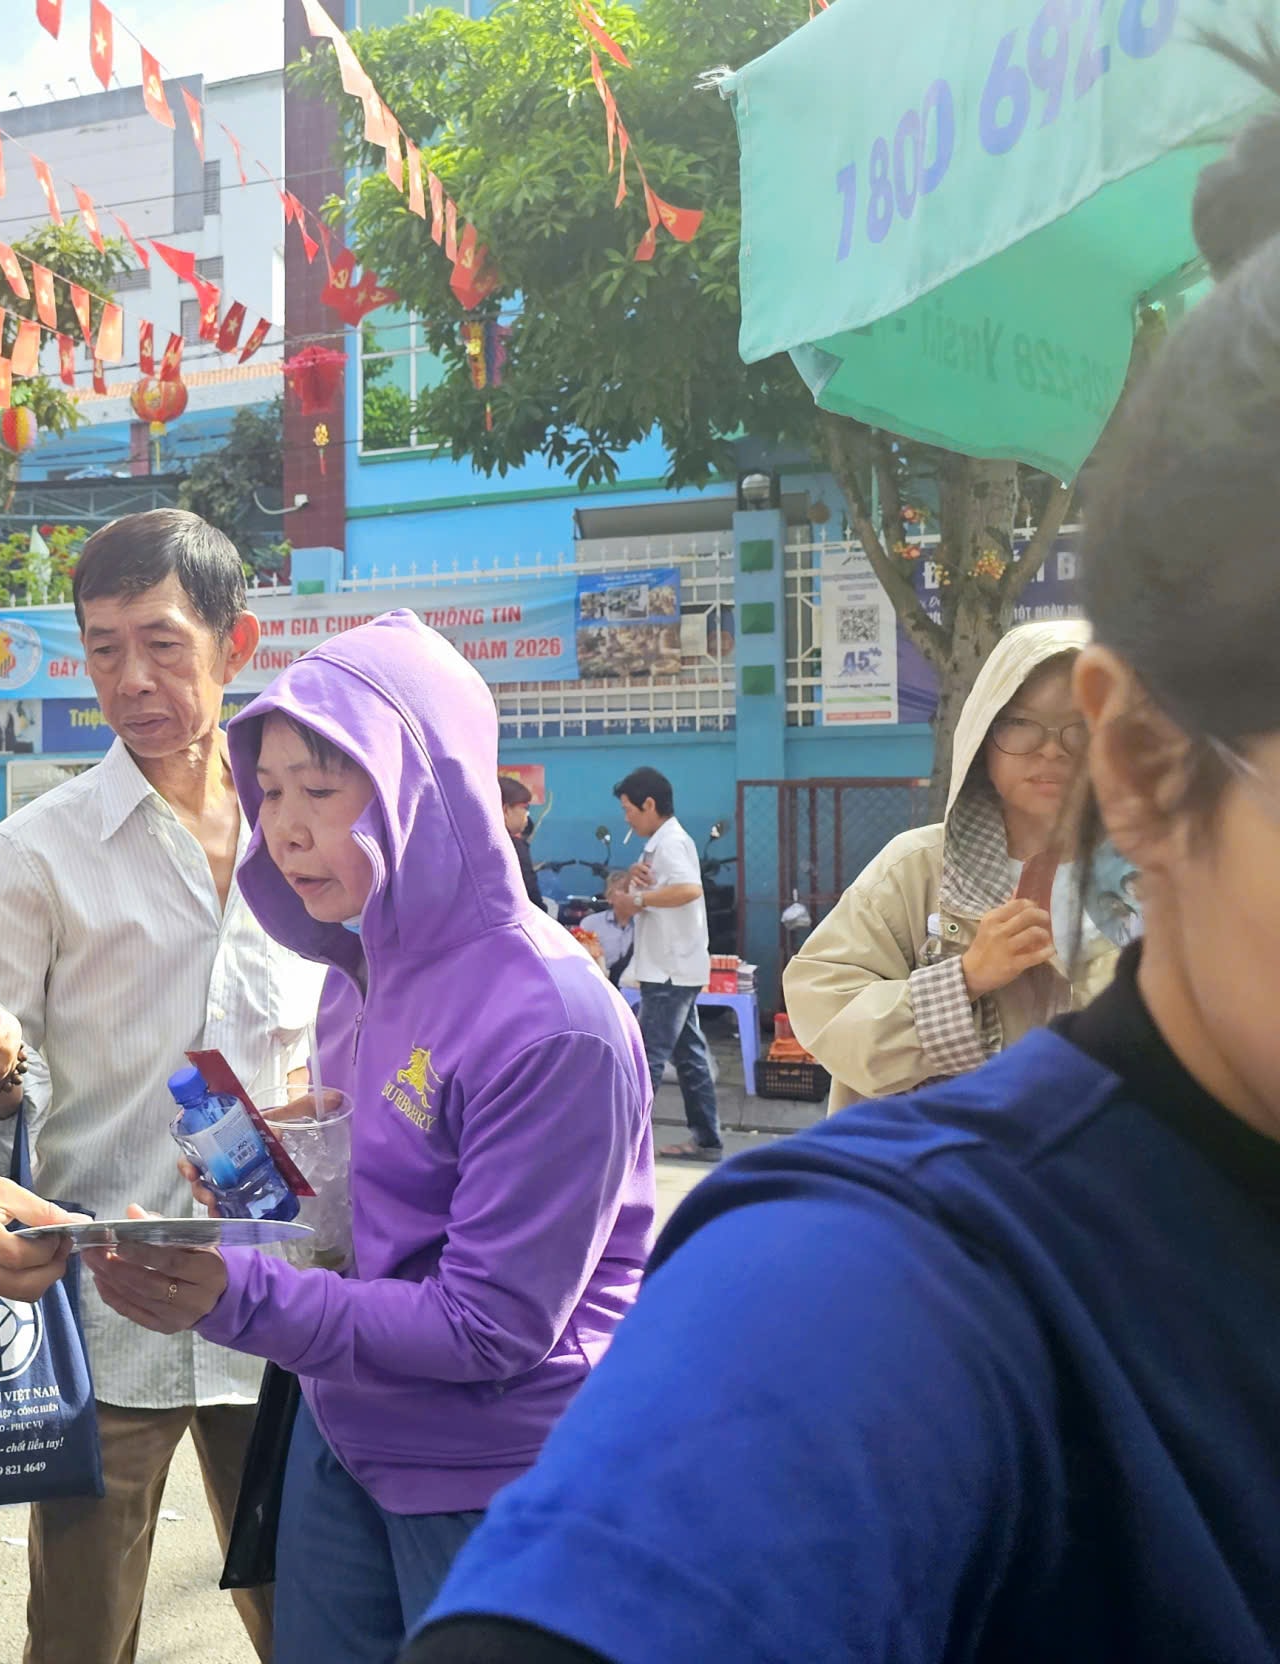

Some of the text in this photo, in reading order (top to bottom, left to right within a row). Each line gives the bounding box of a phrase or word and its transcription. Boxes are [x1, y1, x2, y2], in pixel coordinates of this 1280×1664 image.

[835, 78, 955, 263] 1800
[261, 620, 285, 637] AM
[291, 617, 319, 636] GIA
[423, 606, 485, 627] THÔNG
[491, 605, 523, 624] TIN
[462, 638, 508, 660] NĂM
[513, 637, 563, 658] 2026
[4, 1388, 31, 1404] VIỆT
[33, 1385, 61, 1398] NAM
[46, 1437, 65, 1450] tay!
[5, 1464, 22, 1475] 821
[23, 1461, 47, 1473] 4649
